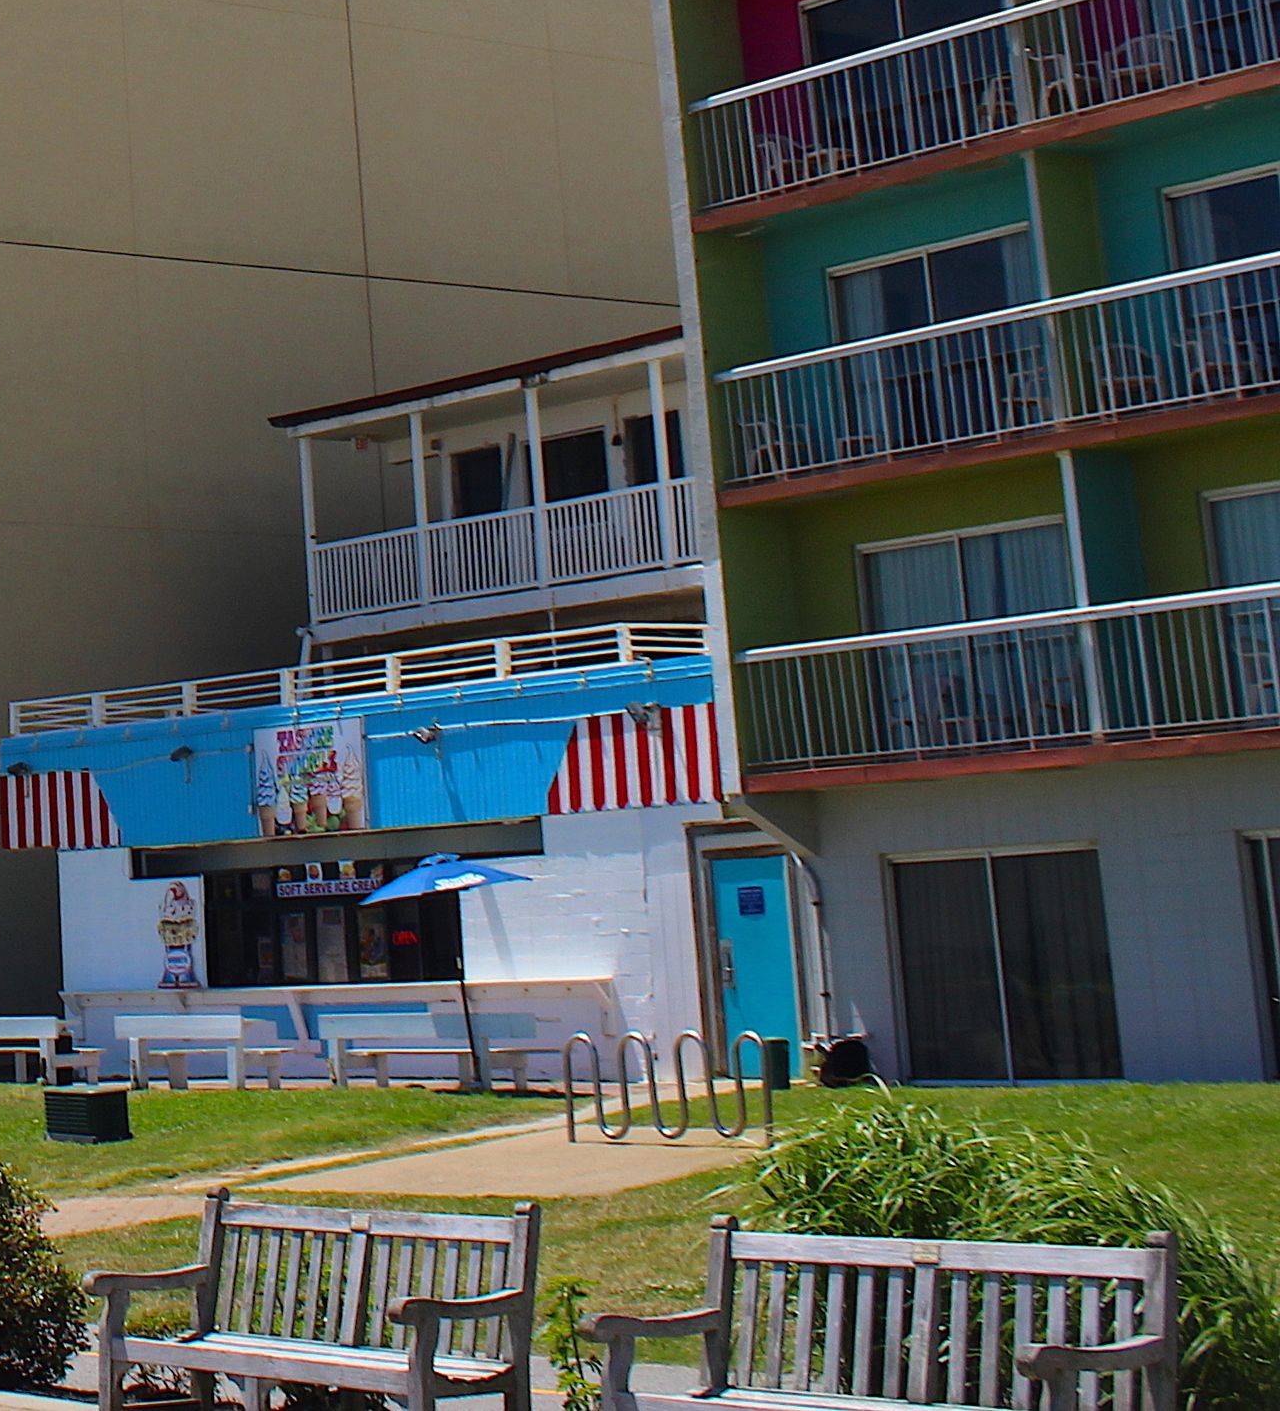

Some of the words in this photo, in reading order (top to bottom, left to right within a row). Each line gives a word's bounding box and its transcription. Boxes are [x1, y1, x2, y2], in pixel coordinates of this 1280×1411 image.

[279, 883, 302, 895] SOFT
[303, 882, 333, 895] SERVE
[335, 880, 350, 893] ICE
